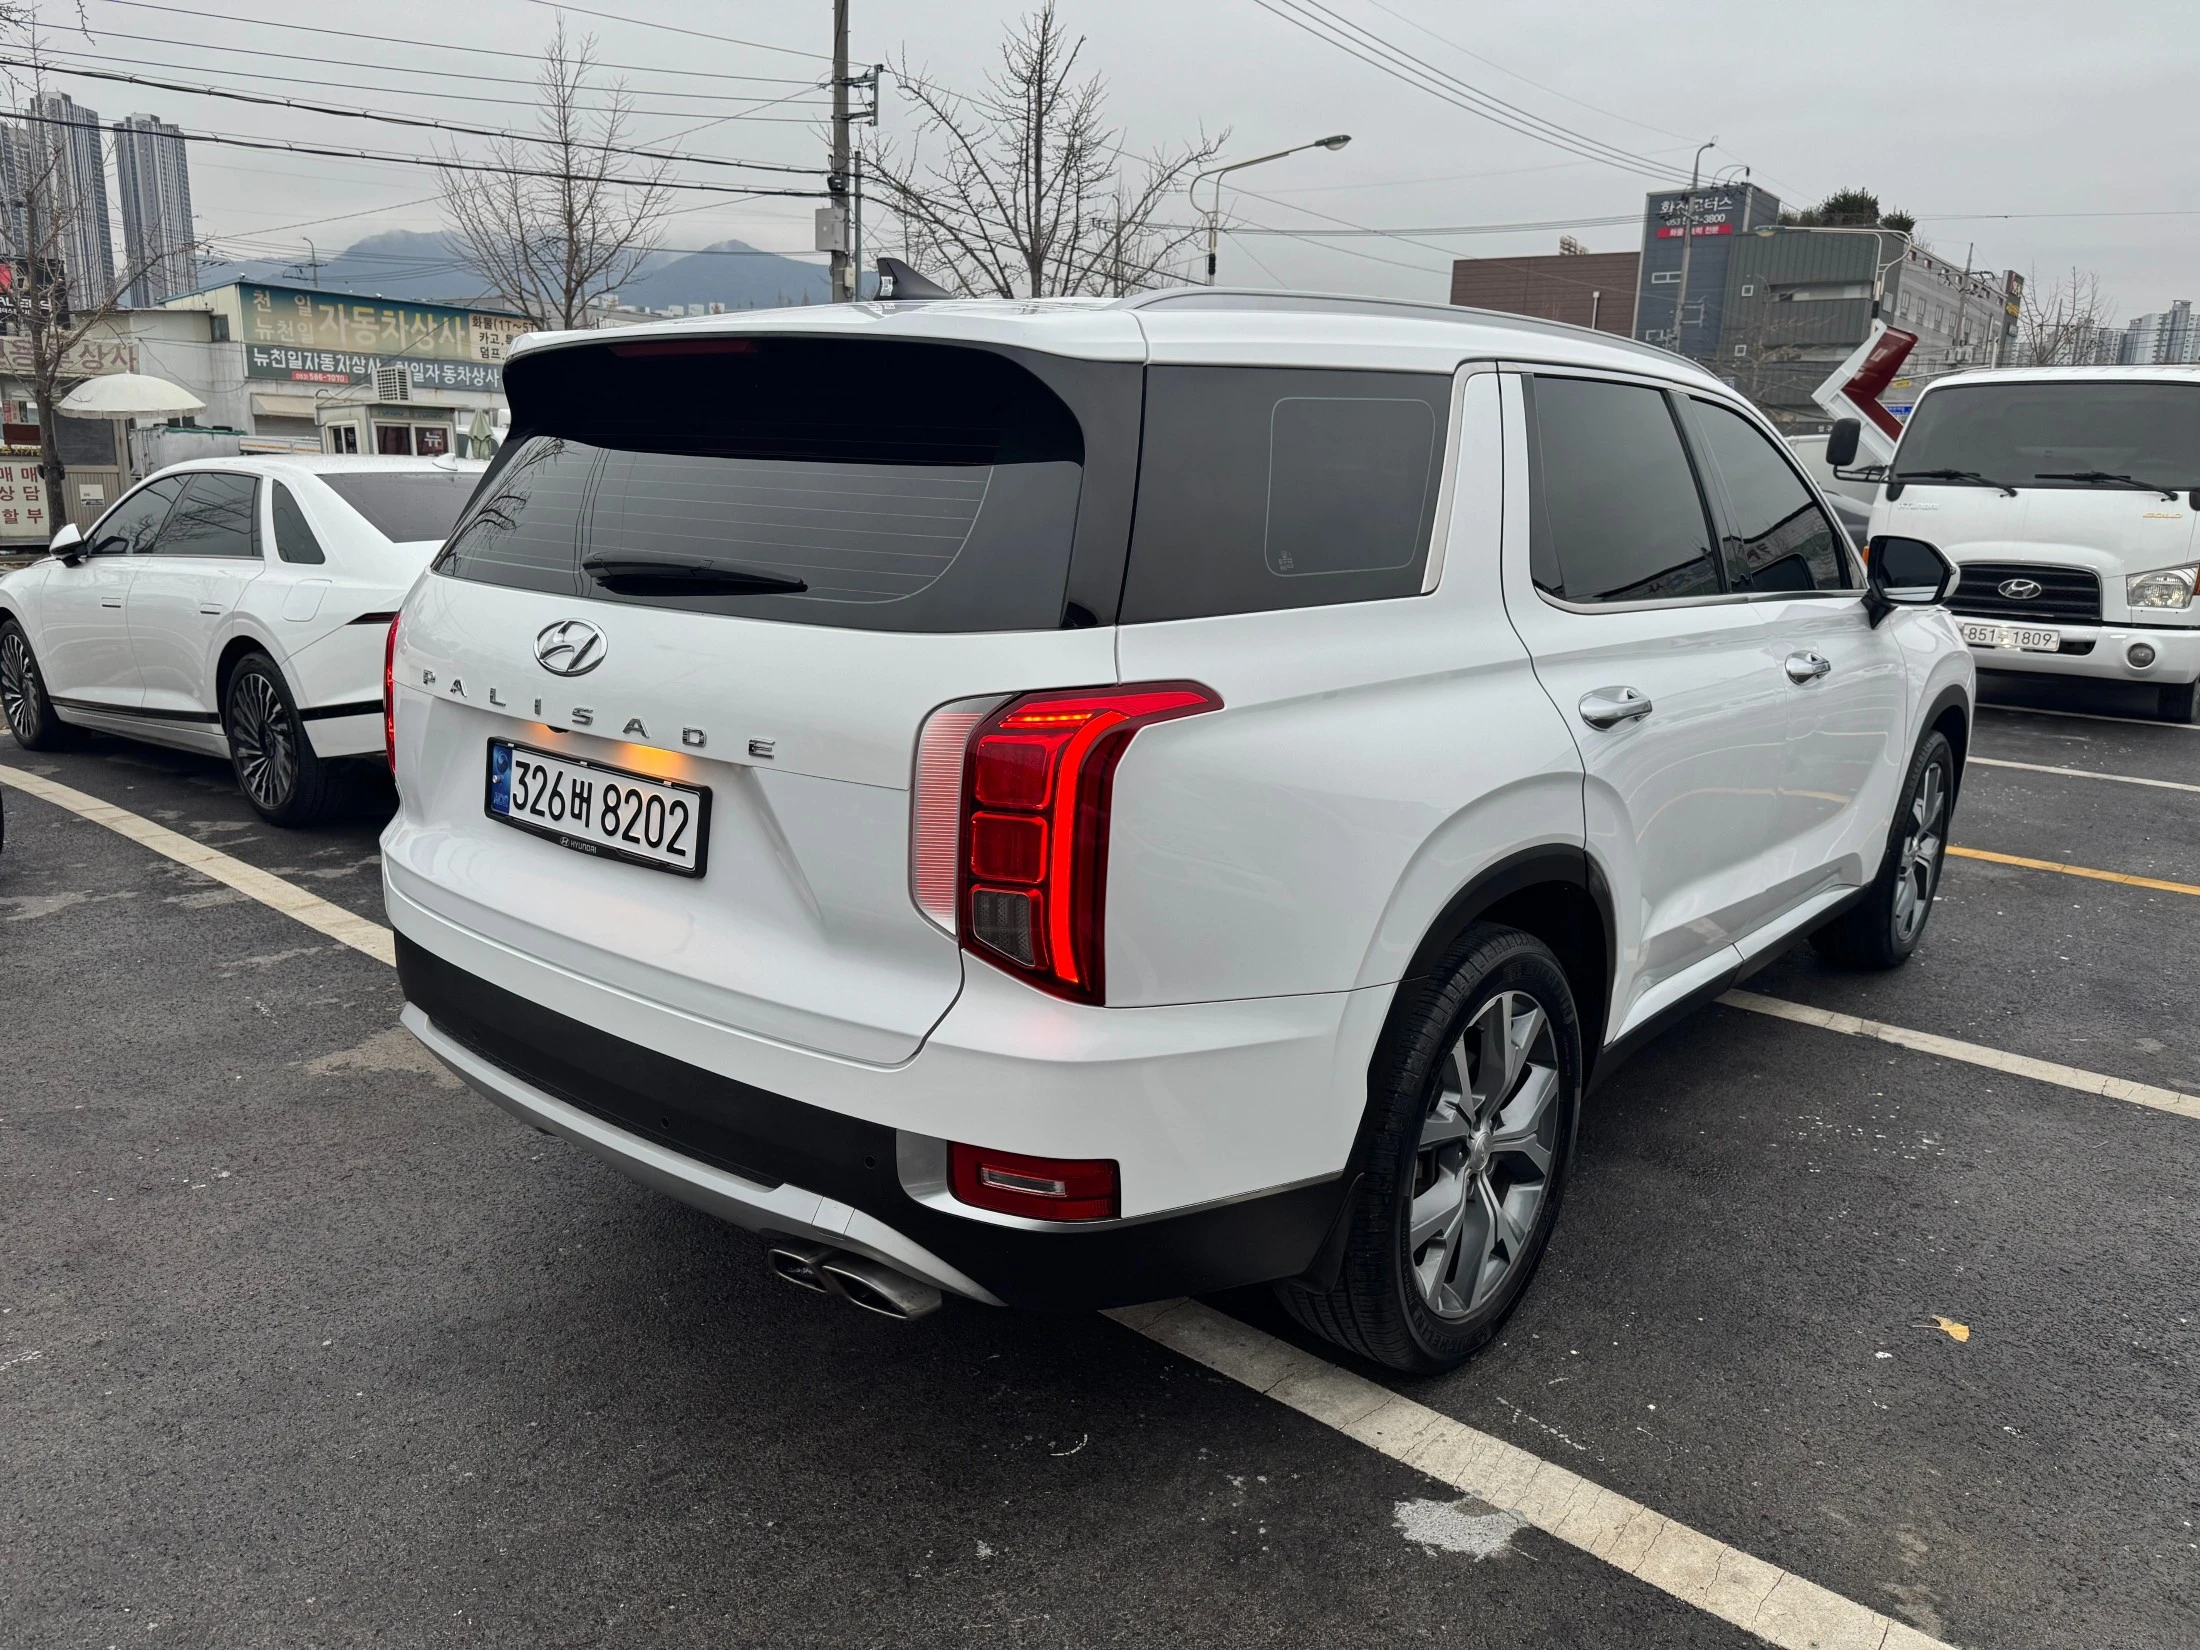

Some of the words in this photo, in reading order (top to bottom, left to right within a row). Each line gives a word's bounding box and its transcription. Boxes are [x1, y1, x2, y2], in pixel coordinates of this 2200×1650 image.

[254, 317, 315, 345] 뉴천일
[318, 303, 466, 353] 자동차상사
[253, 347, 382, 375] 뉴천일자동차상사
[423, 431, 441, 447] 뉴
[2012, 631, 2052, 647] 1809
[423, 669, 776, 760] PALISADE
[512, 760, 593, 829] 326버
[600, 783, 689, 857] 8202
[570, 839, 597, 854] HYUNDAI
